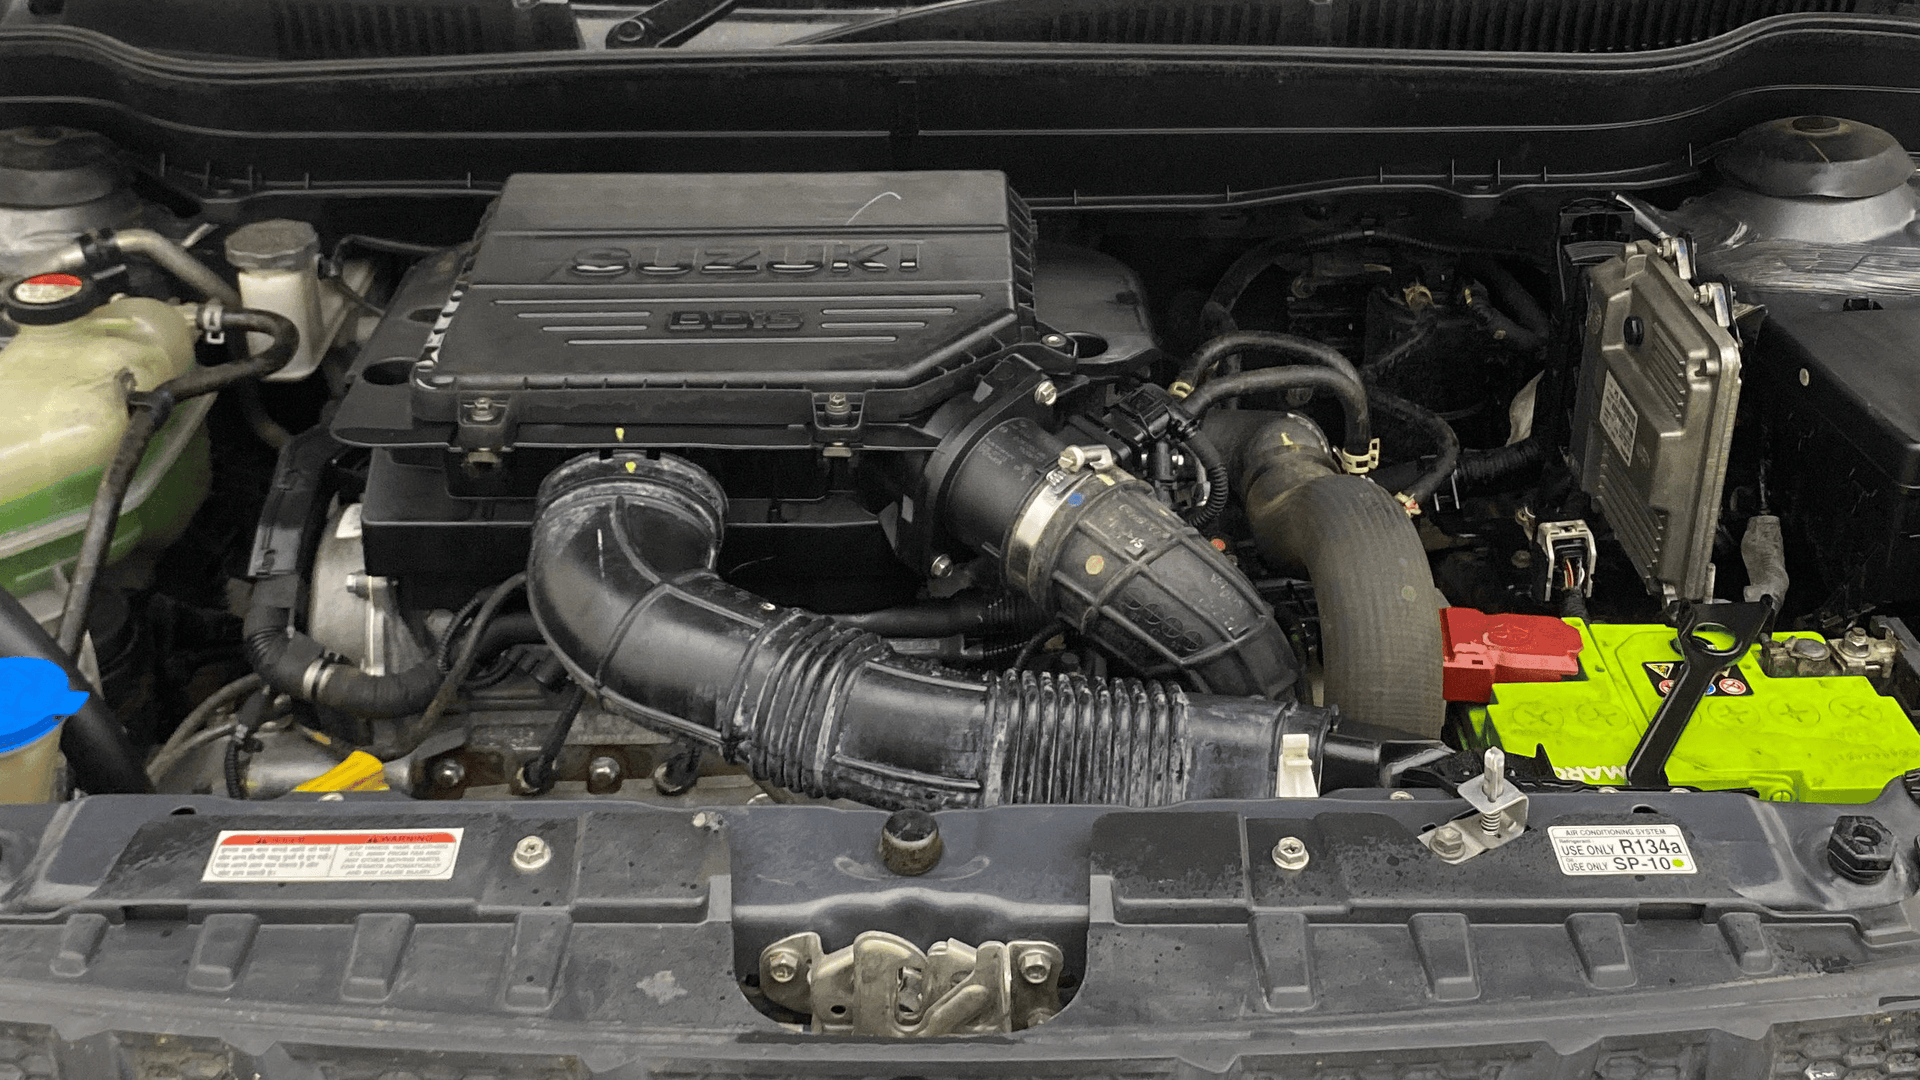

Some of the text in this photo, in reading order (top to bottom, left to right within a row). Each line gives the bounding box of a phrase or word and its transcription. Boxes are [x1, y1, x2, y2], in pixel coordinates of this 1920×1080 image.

[571, 244, 919, 276] SUZUKI
[1561, 839, 1683, 856] USE ONLY R134a
[1567, 856, 1671, 872] USE ONLY SP-10
